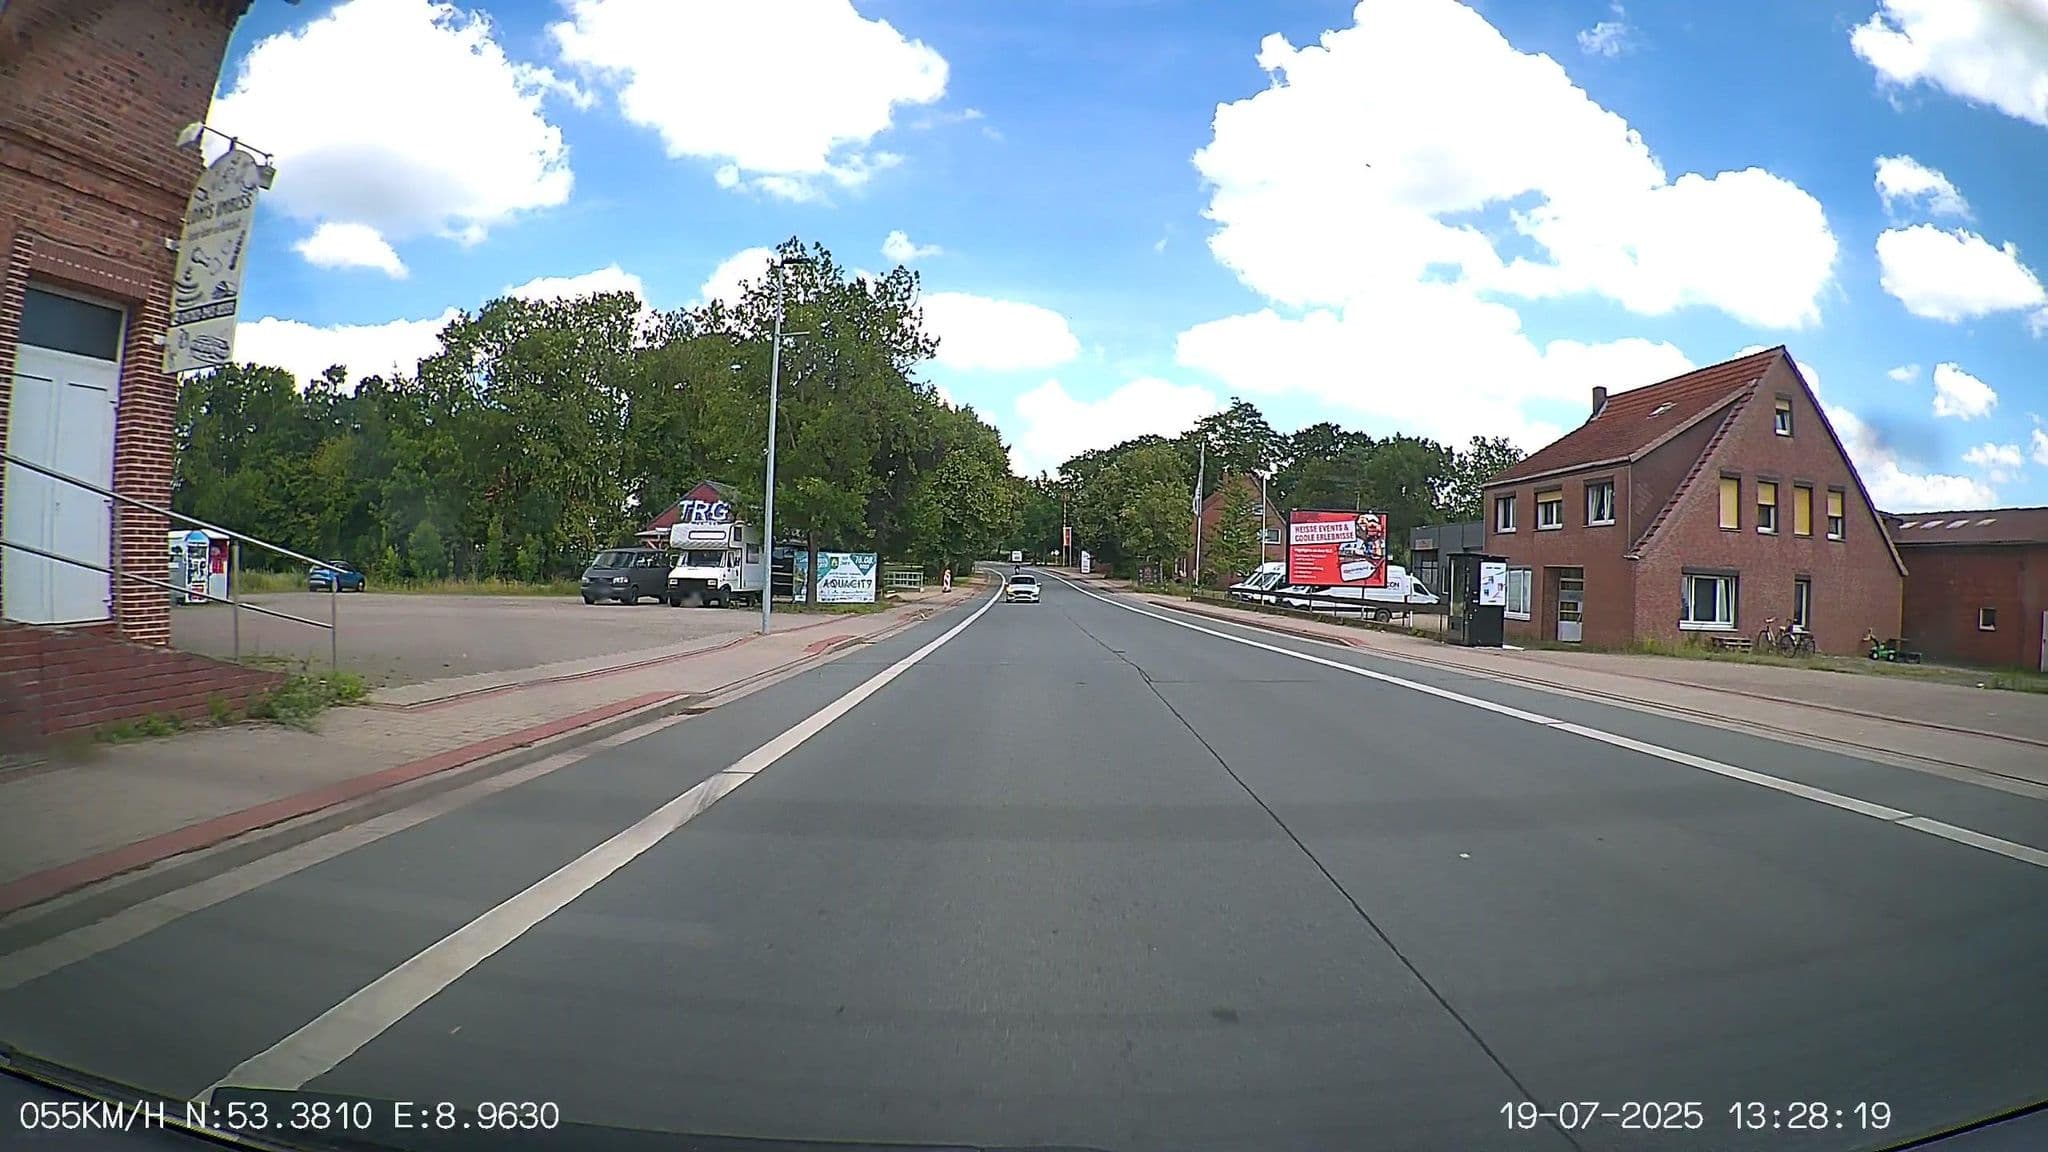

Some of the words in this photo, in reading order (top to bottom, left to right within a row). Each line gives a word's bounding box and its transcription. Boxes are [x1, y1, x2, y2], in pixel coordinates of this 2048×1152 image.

[679, 499, 730, 521] TRG
[1295, 524, 1317, 533] HEISSE
[1319, 523, 1342, 532] EVENTS
[1295, 533, 1314, 542] COOLE
[1317, 531, 1354, 541] ERLEBNISSE
[823, 579, 873, 589] AQUACITY
